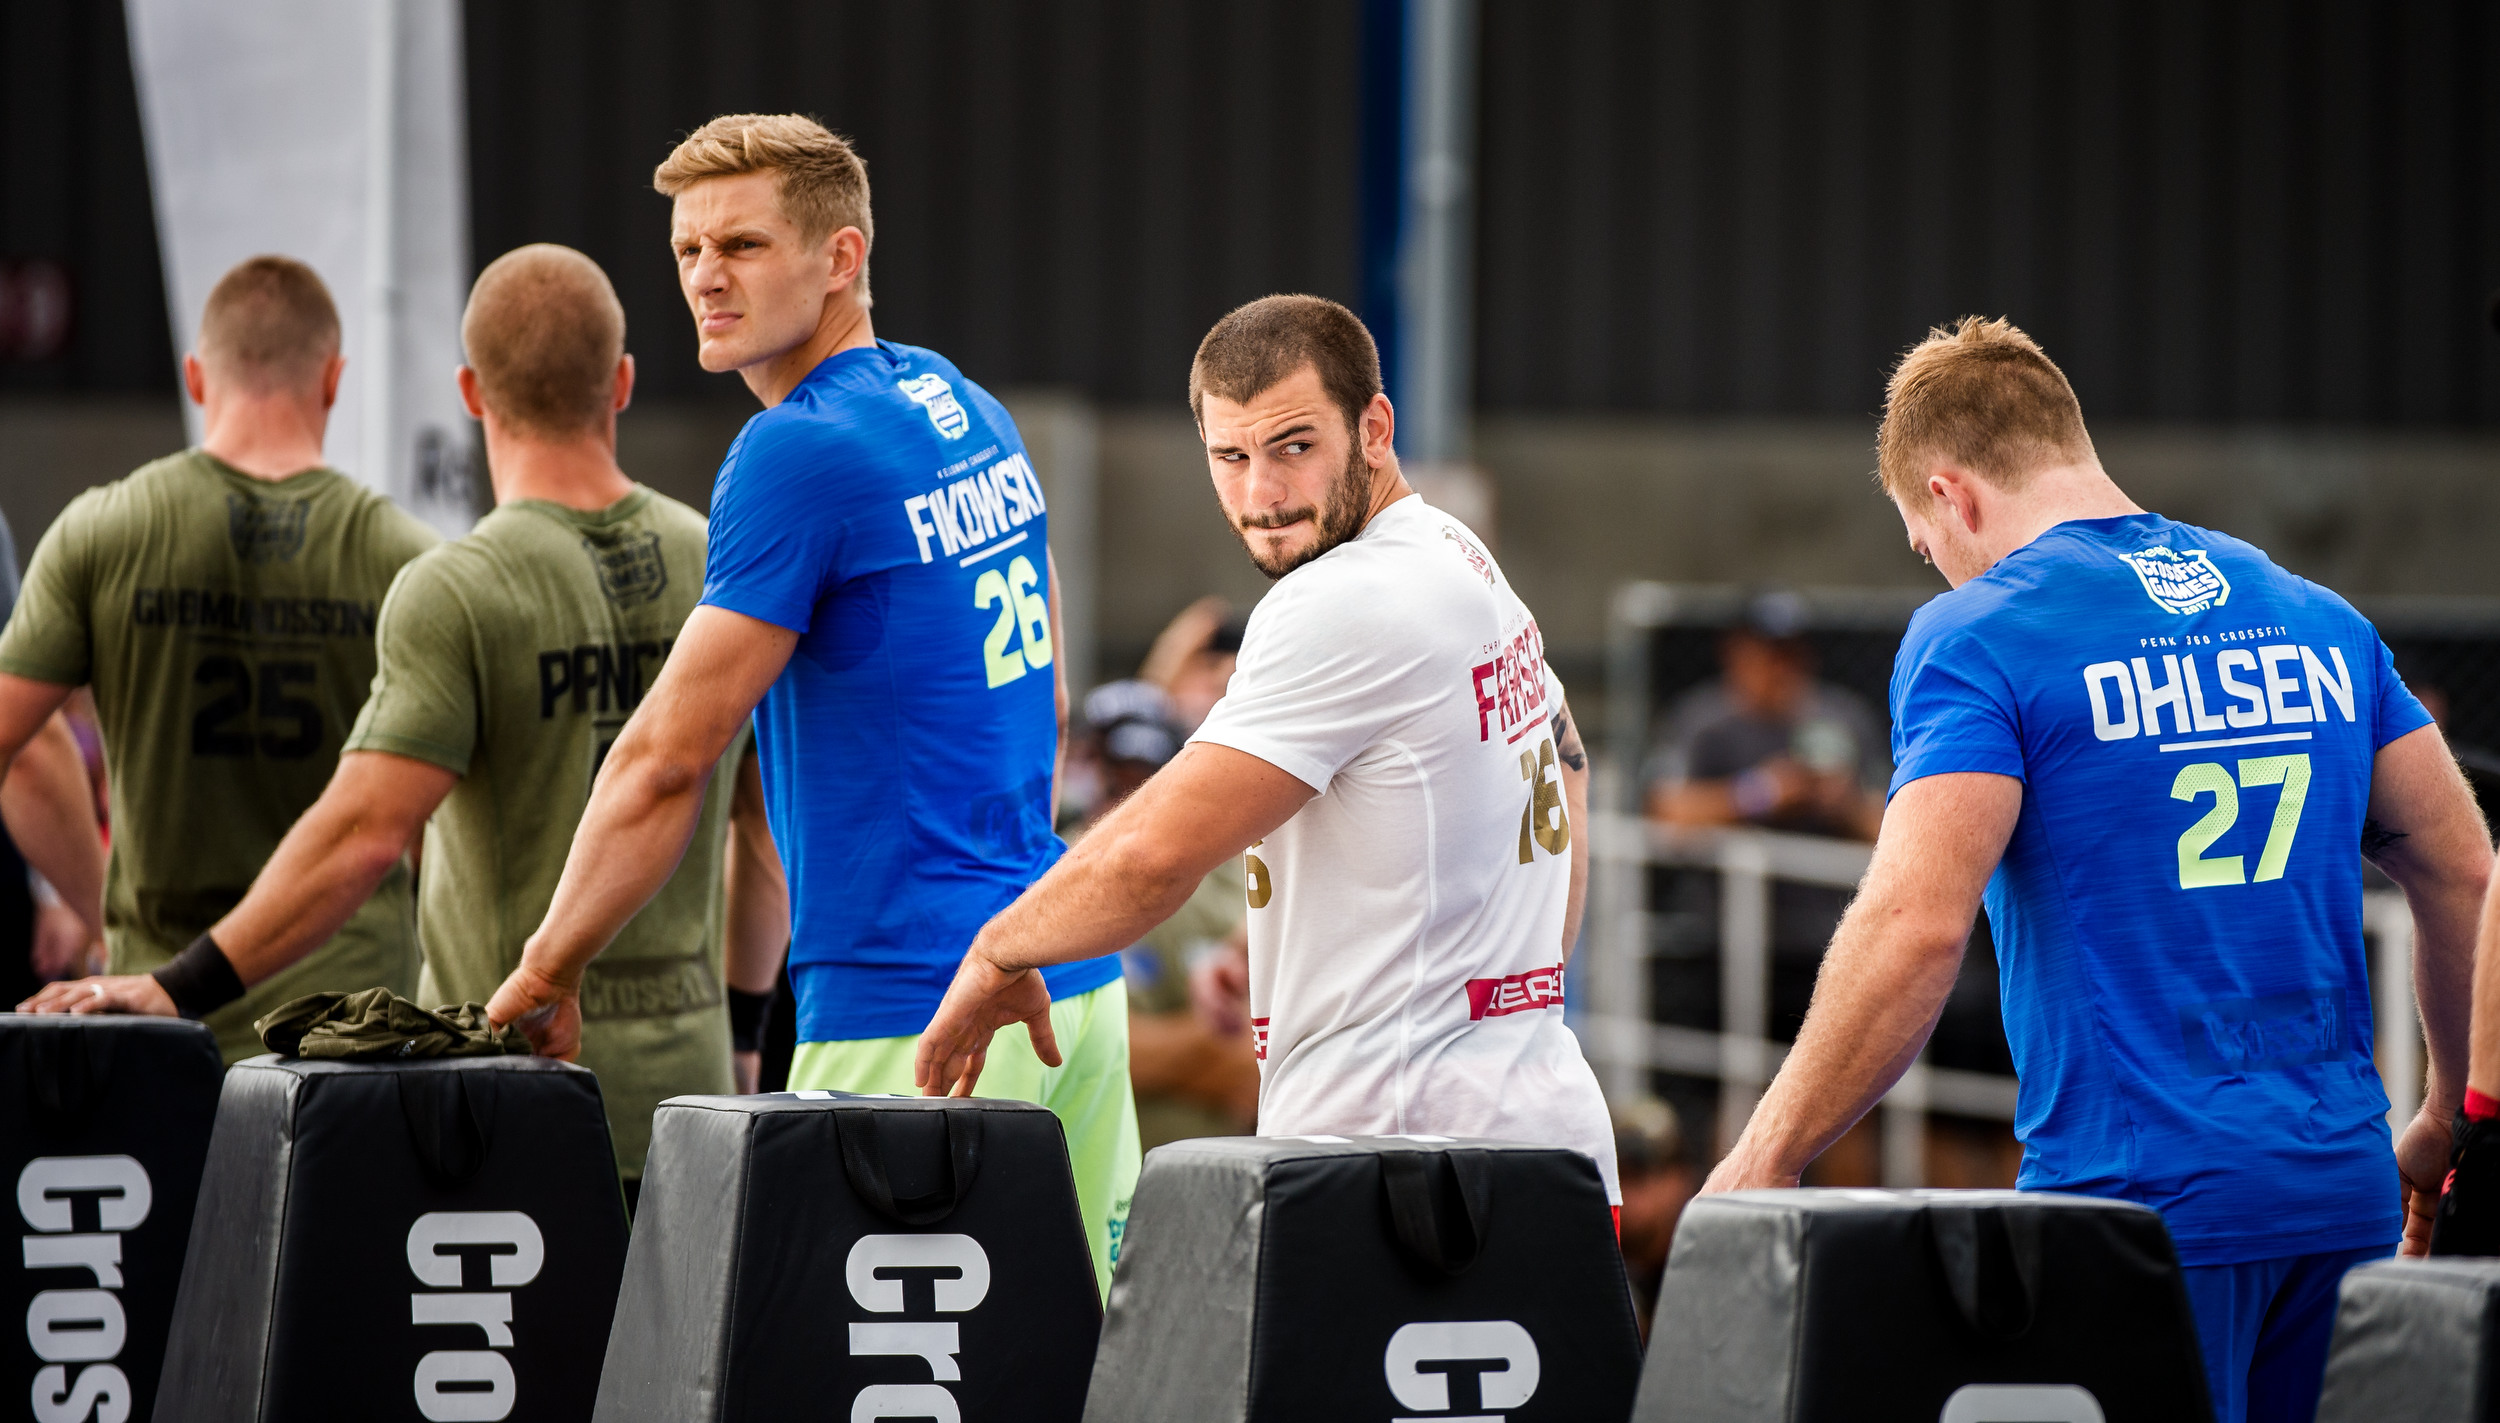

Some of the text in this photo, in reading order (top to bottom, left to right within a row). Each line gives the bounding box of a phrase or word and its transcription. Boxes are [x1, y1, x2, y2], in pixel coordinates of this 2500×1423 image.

[904, 451, 1047, 564] FIKOWSKI
[974, 555, 1054, 690] 26
[2140, 625, 2288, 648] PEAK 360 CROSSFIT
[2148, 572, 2221, 600] GAMES
[2181, 599, 2211, 616] 2017
[191, 655, 325, 761] 25
[2083, 644, 2356, 742] OHLSEN
[2169, 752, 2312, 890] 27
[16, 1153, 153, 1423] Cros
[406, 1210, 545, 1423] Cro
[1383, 1319, 1542, 1423] C
